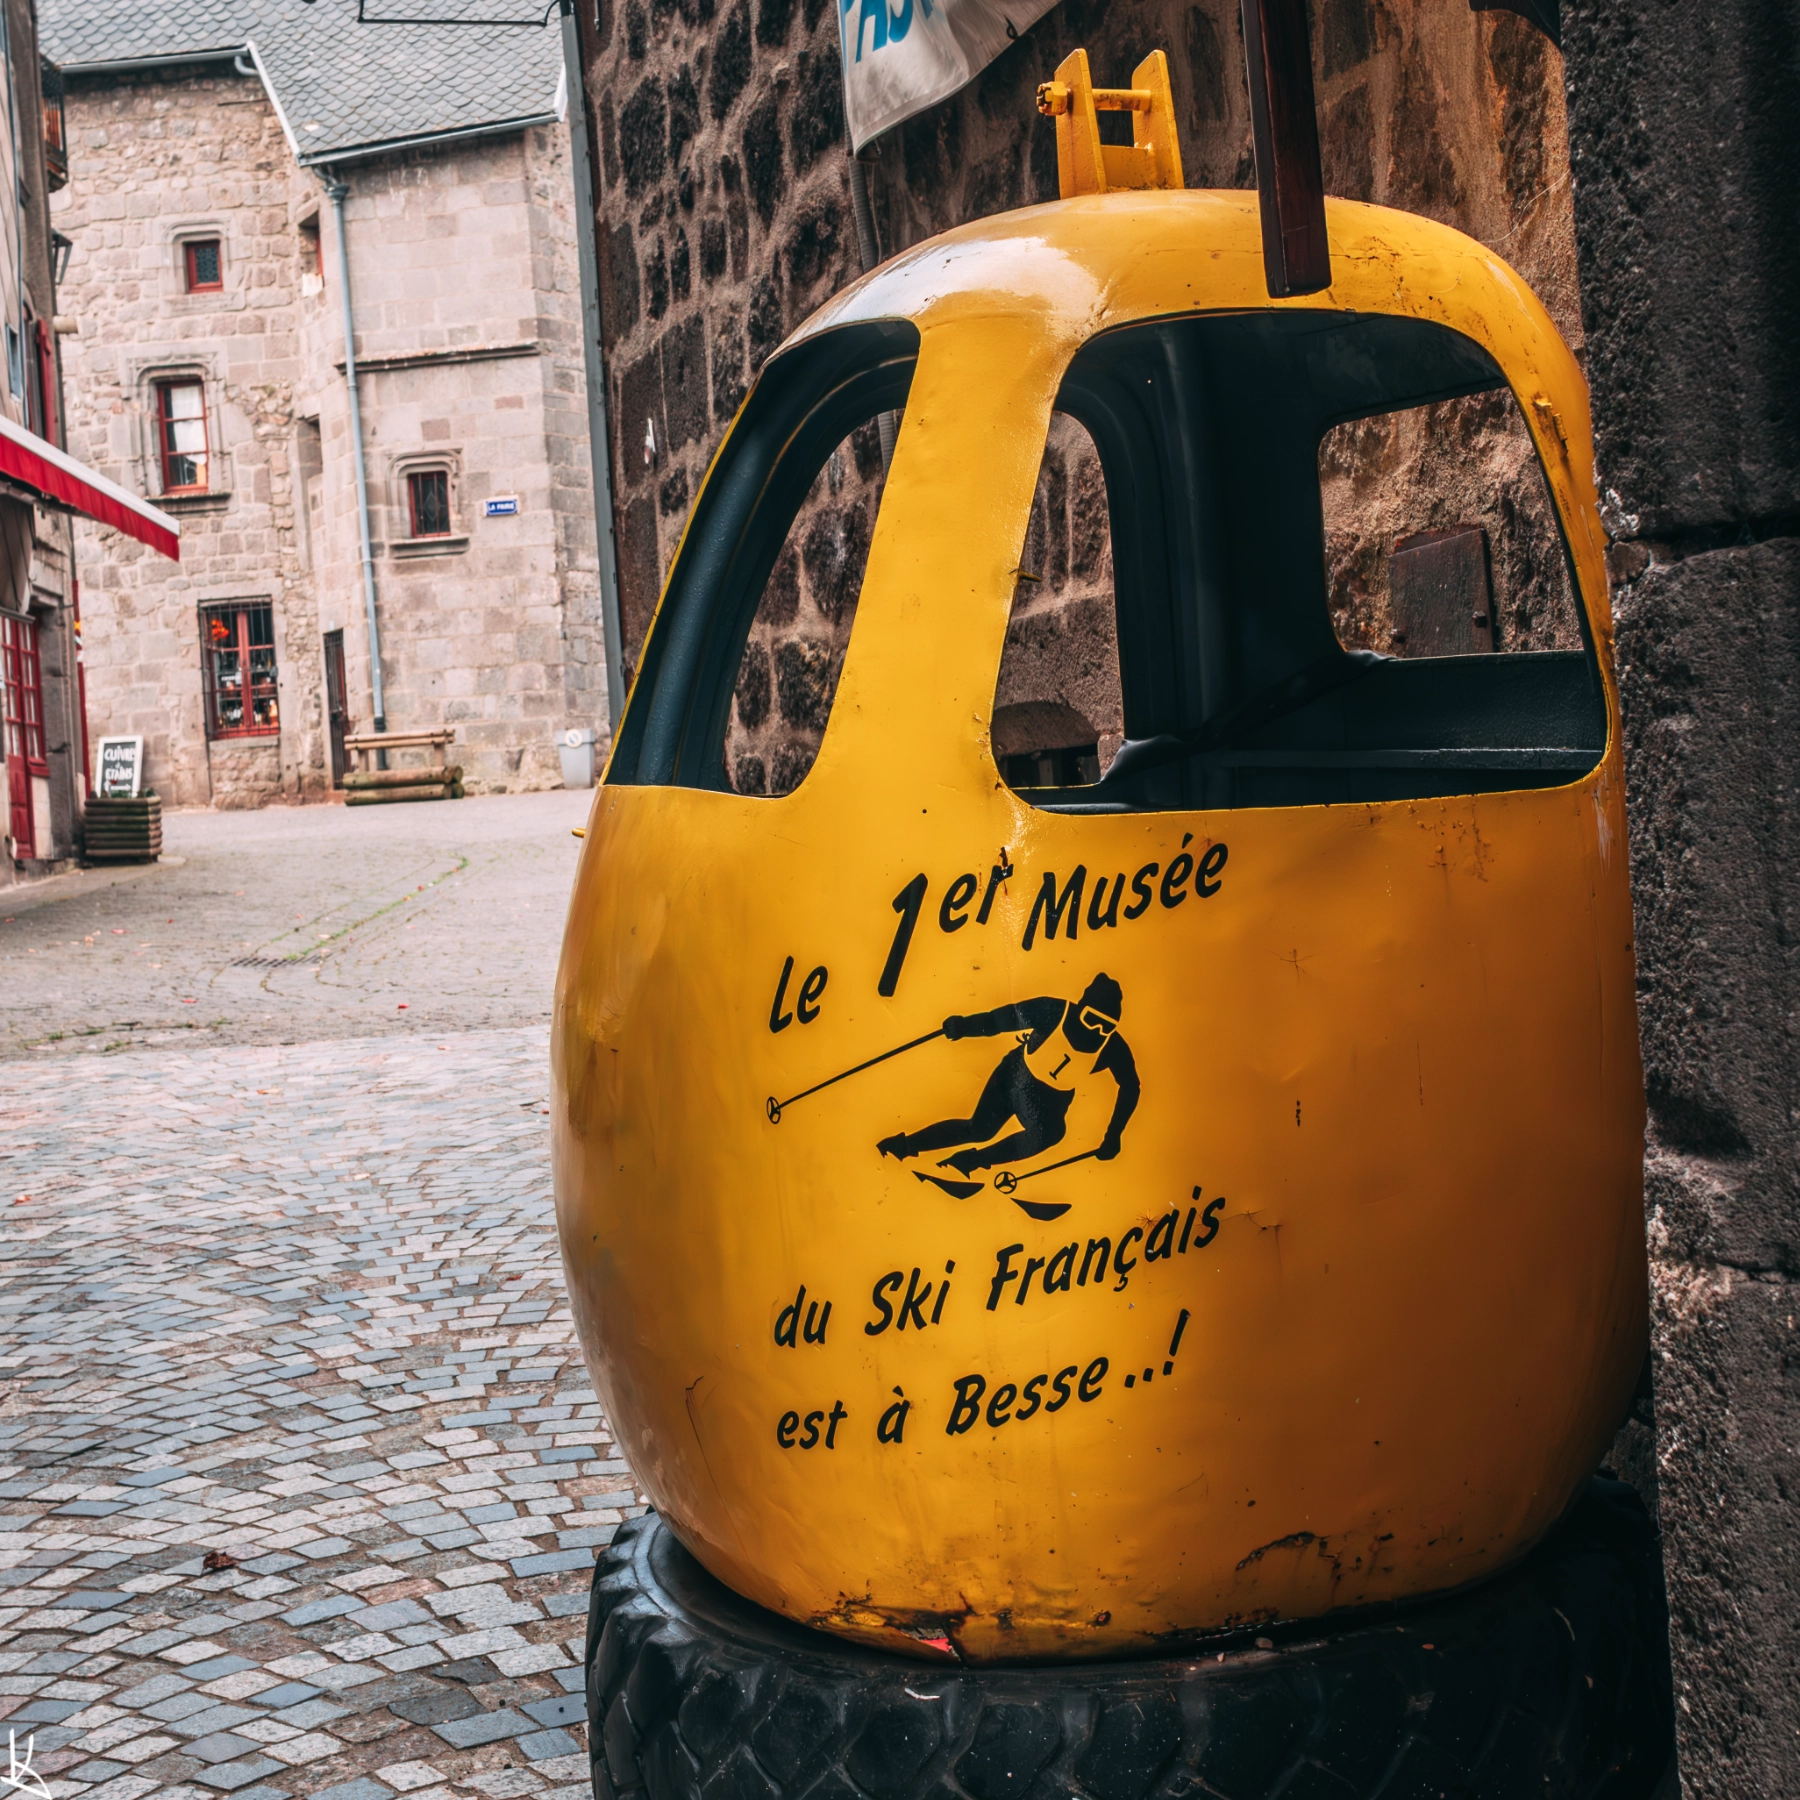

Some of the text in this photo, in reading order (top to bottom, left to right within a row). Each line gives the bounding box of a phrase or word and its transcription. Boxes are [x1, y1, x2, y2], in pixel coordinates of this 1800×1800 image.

[769, 832, 1229, 1034] Le 1er Musée
[773, 1185, 1226, 1349] du Ski Français
[776, 1400, 848, 1450] est
[876, 1385, 911, 1444] à
